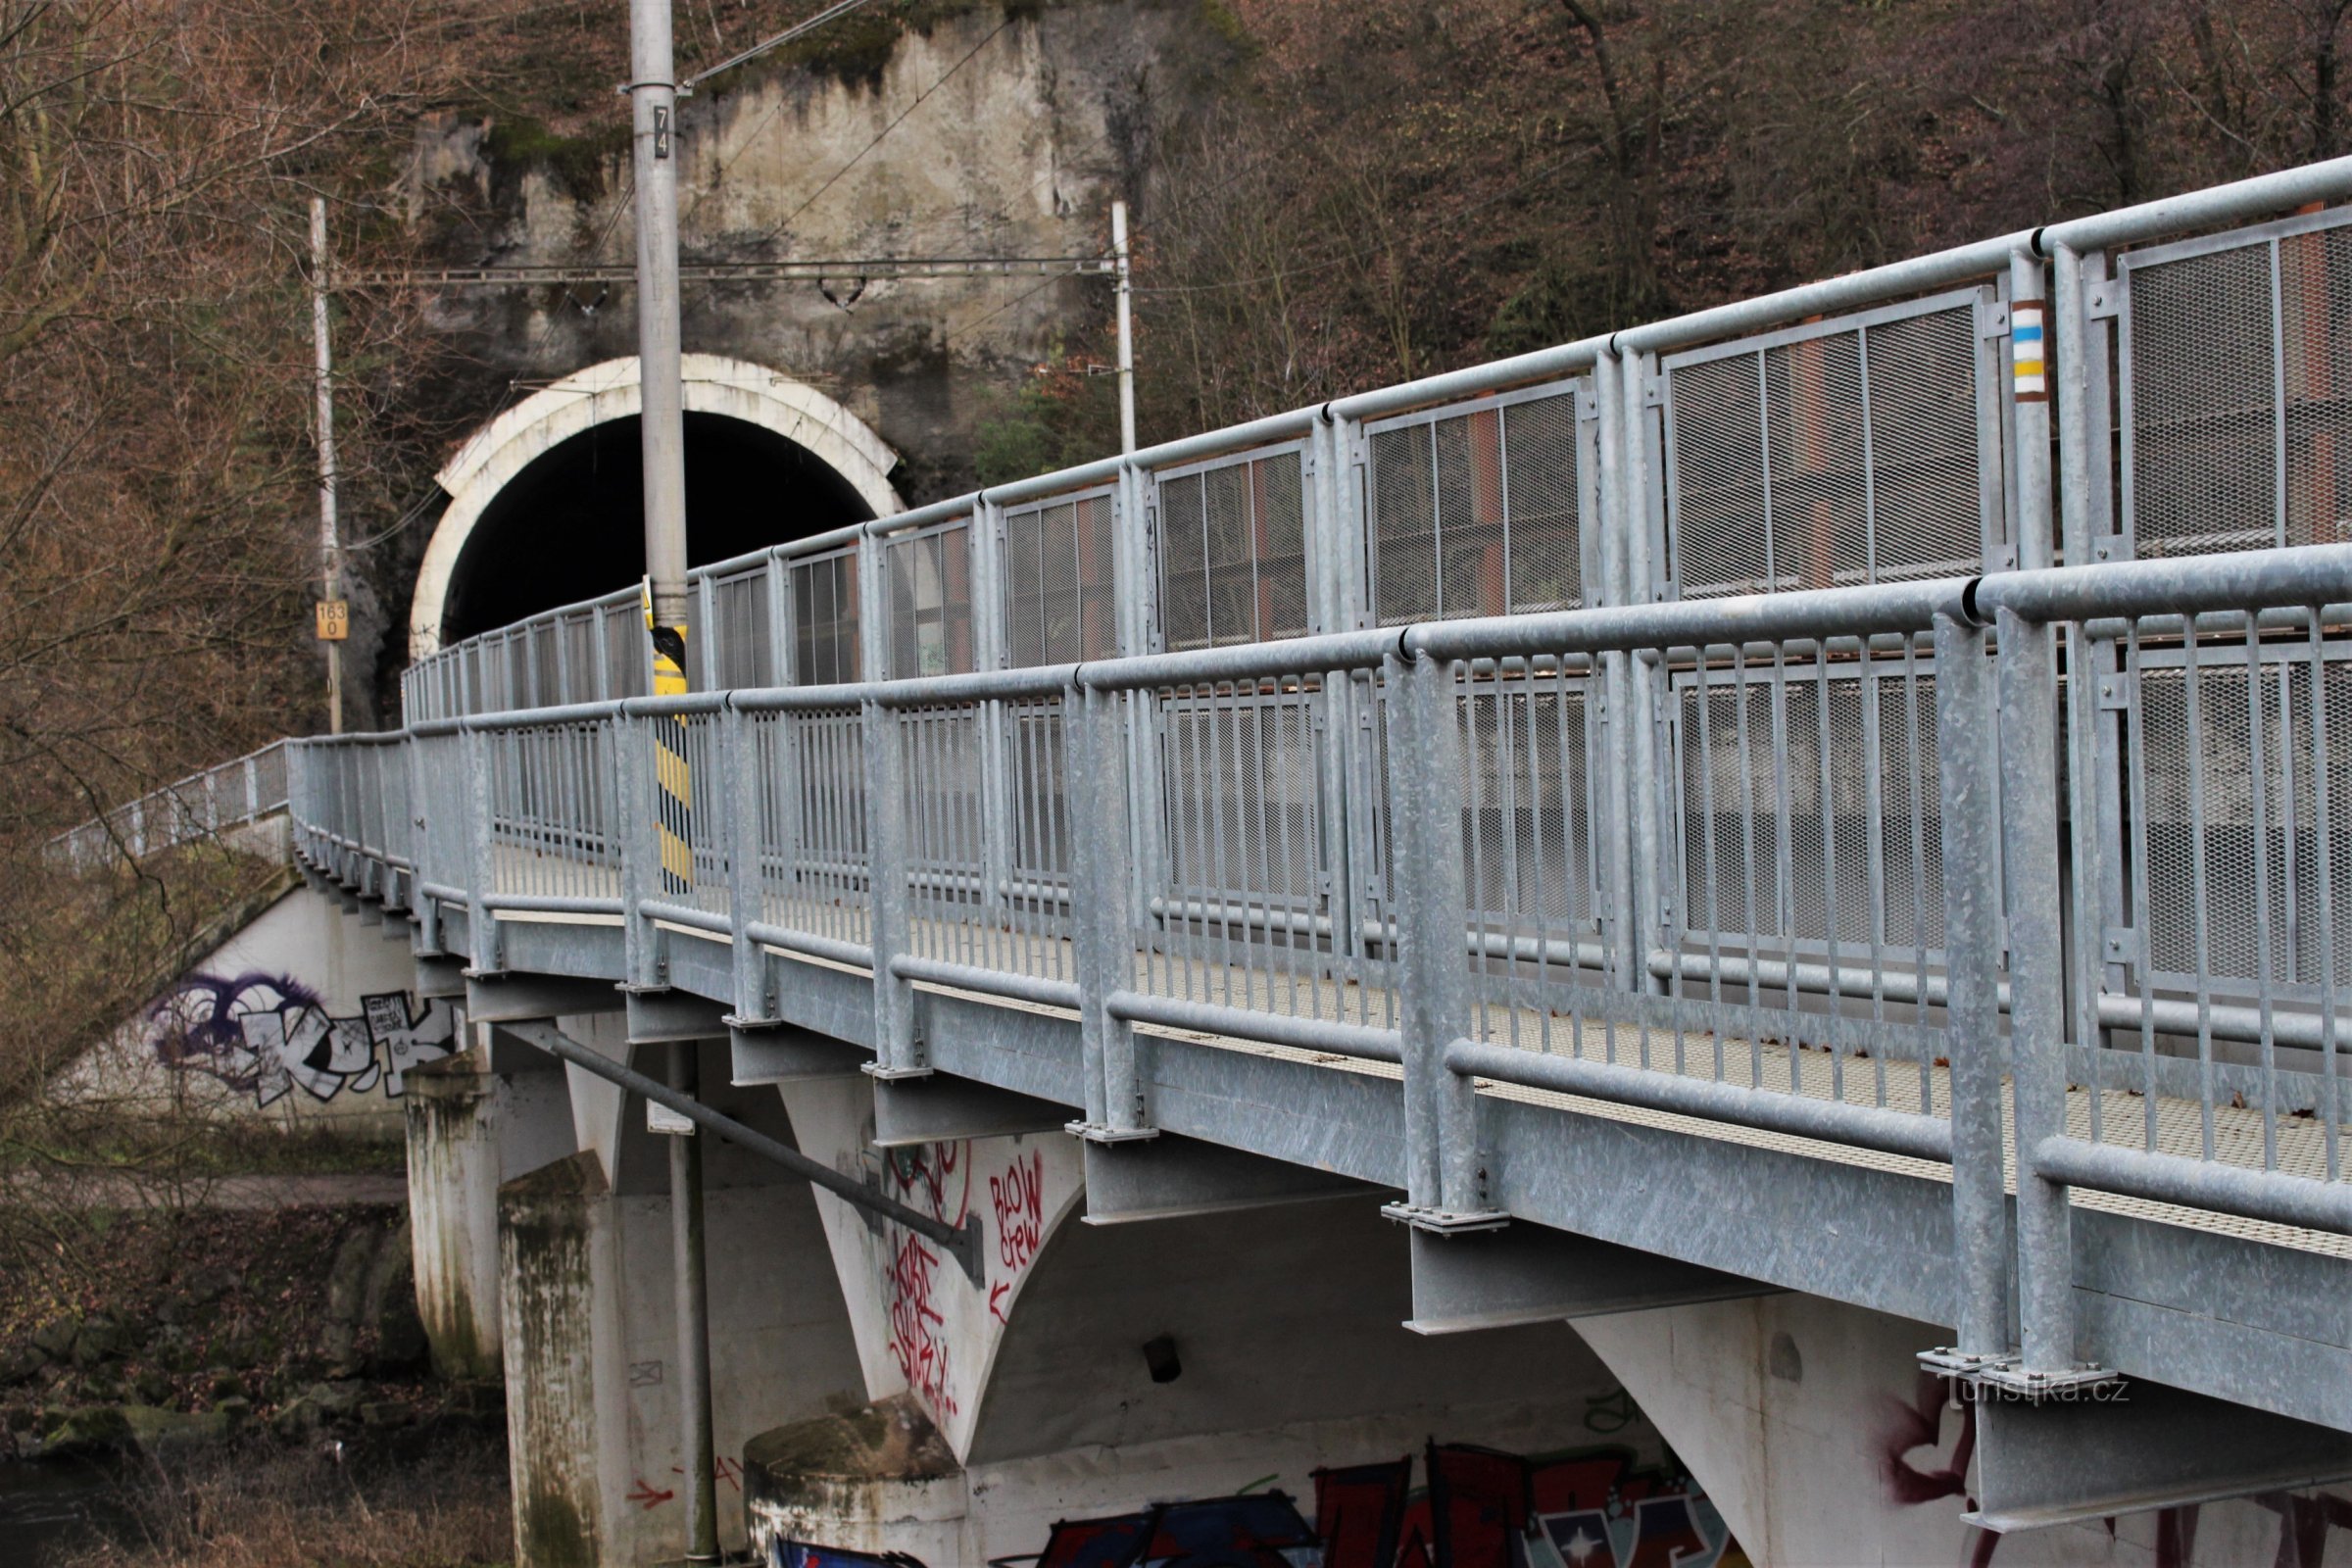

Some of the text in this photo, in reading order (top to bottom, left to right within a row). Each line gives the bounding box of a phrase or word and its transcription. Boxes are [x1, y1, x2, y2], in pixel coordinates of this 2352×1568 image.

[658, 109, 667, 152] 74
[319, 605, 346, 620] 163
[327, 620, 337, 636] 0
[990, 1150, 1043, 1225] BLOW
